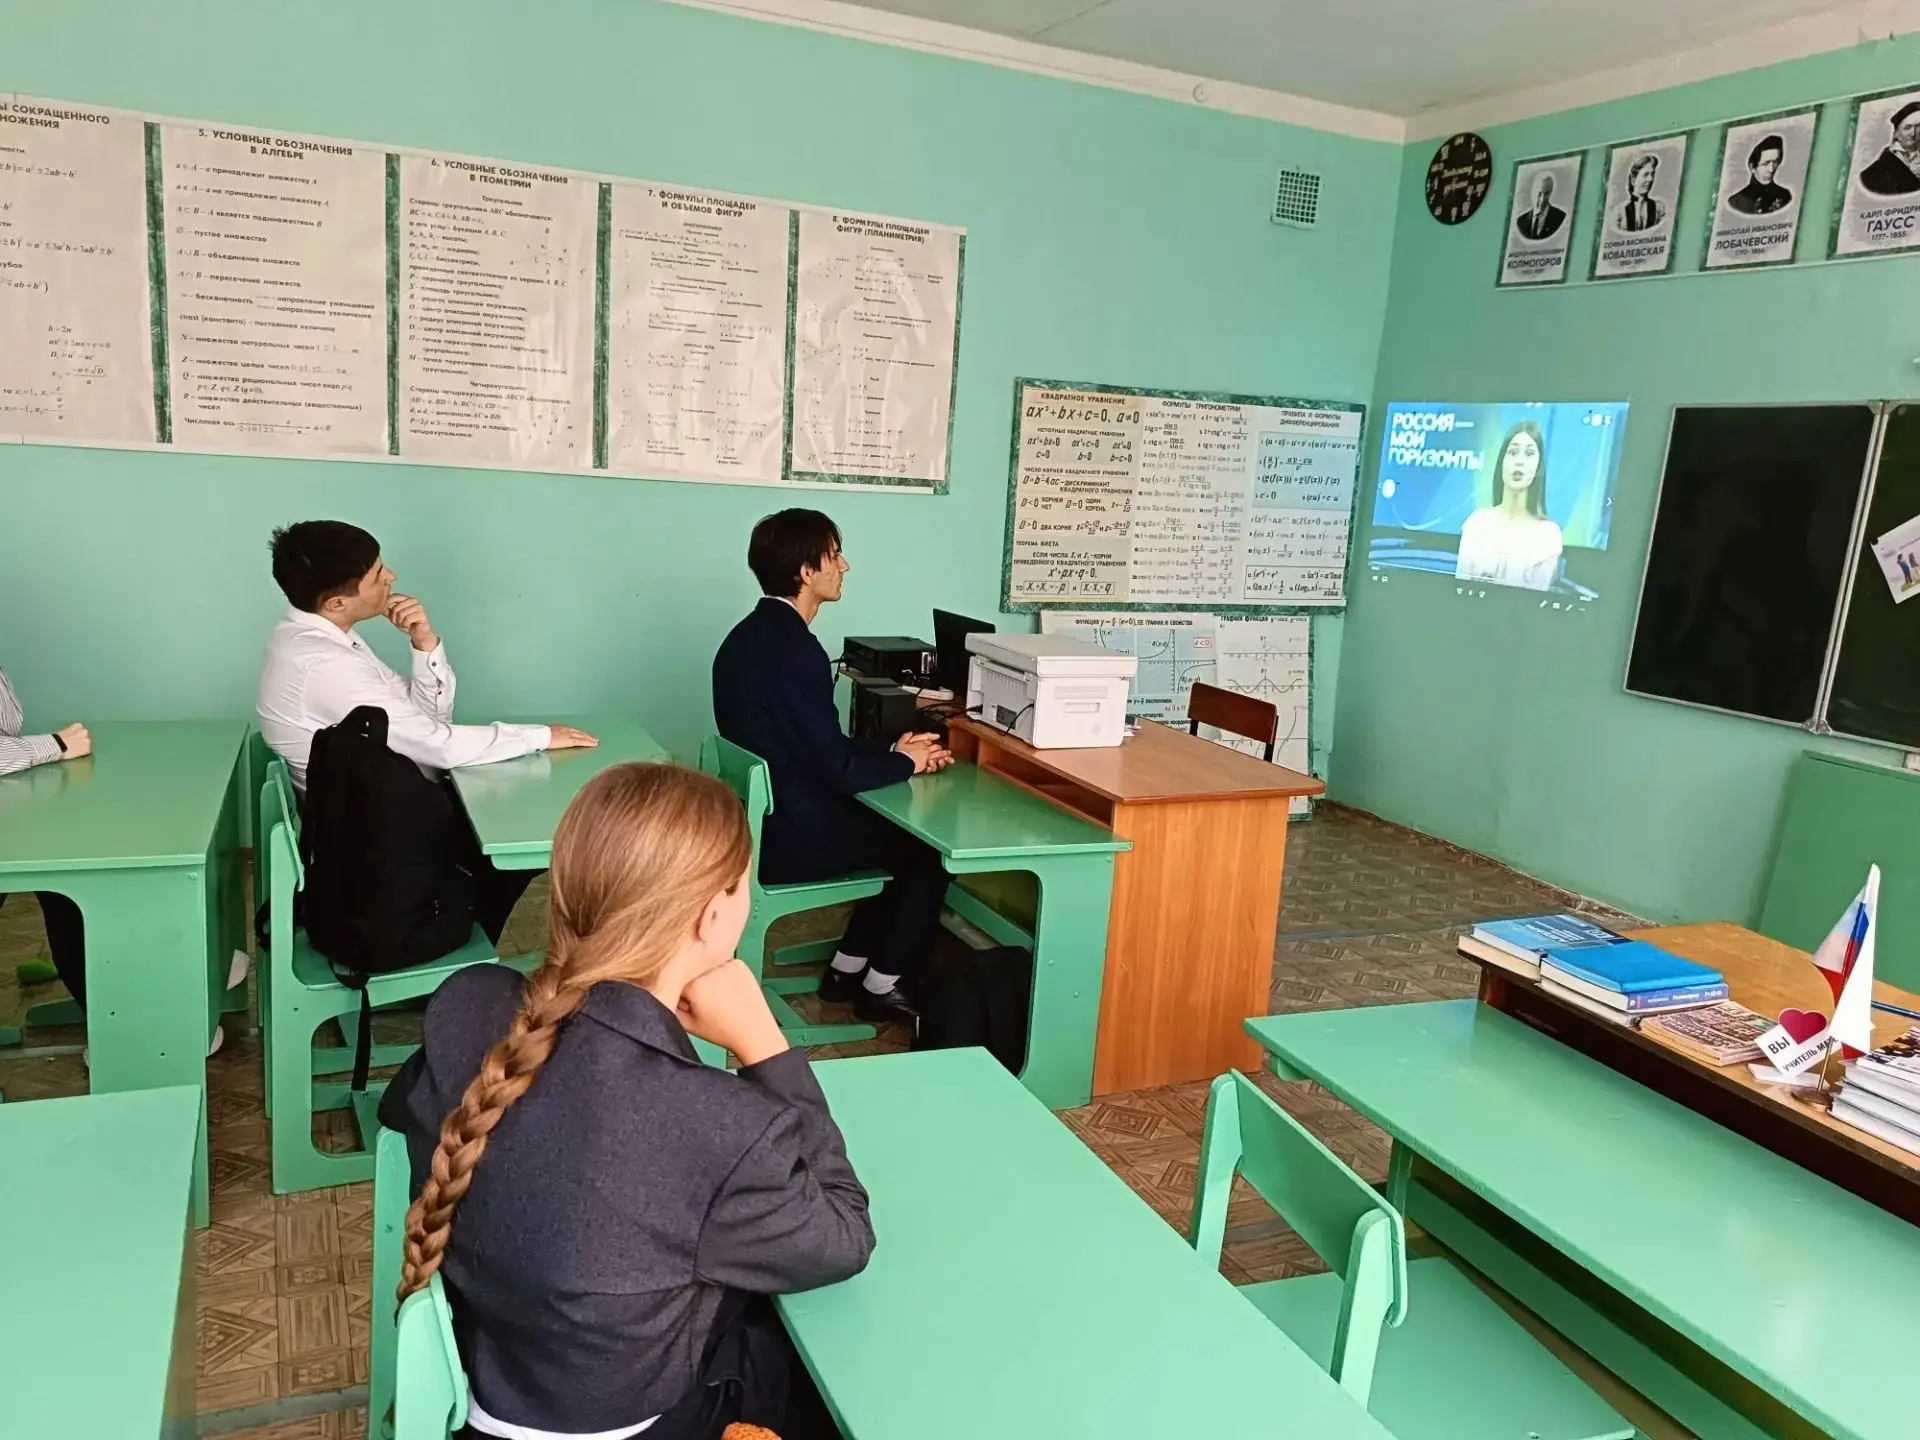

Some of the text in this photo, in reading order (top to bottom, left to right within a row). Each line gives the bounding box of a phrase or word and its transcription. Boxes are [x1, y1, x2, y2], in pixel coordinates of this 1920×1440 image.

[12, 104, 110, 124] СОКРАЩЕННОГО
[198, 129, 353, 156] 5. УСЛОВНЫЕ ОБОЗНАЧЕНИЯ
[250, 146, 304, 160] В АЛГЕБРЕ
[212, 168, 265, 179] принадлежит
[431, 159, 568, 184] 6. УСЛОВНЫЕ ОБОЗНАЧЕНИЯ
[470, 174, 532, 189] В ГЕОМЕТРИИ
[225, 190, 278, 201] принадлежит
[659, 190, 704, 203] ФОРМУЛЫ
[671, 202, 712, 214] ОБЪЕМОВ
[715, 208, 743, 218] ФИГУР
[1860, 210, 1883, 220] КАРЛ
[832, 216, 840, 224] 8.
[842, 217, 883, 228] ФОРМУЛЫ
[1752, 222, 1793, 233] ИВАНОВИЧ
[1866, 216, 1916, 233] ГАУСС
[224, 233, 267, 243] множество
[836, 225, 924, 244] ФИГУР (ПЛАНИМЕТРИЯ)
[1715, 233, 1789, 249] ЛОБАЧЕВСКИЙ
[1603, 246, 1665, 260] КОВАЛЕВСКАЯ
[1507, 257, 1562, 269] КОЛМОГОРОВ
[1041, 393, 1126, 404] КВАДРАТНОЕ УРАВНЕНИЕ
[1195, 403, 1241, 411] ТРИГОНОМЕТРИИ
[1388, 447, 1485, 470] ГОРИЗОНТЫ
[1768, 1037, 1791, 1054] ВЫ
[1782, 1048, 1818, 1072] УЧИТЕЛЬ
